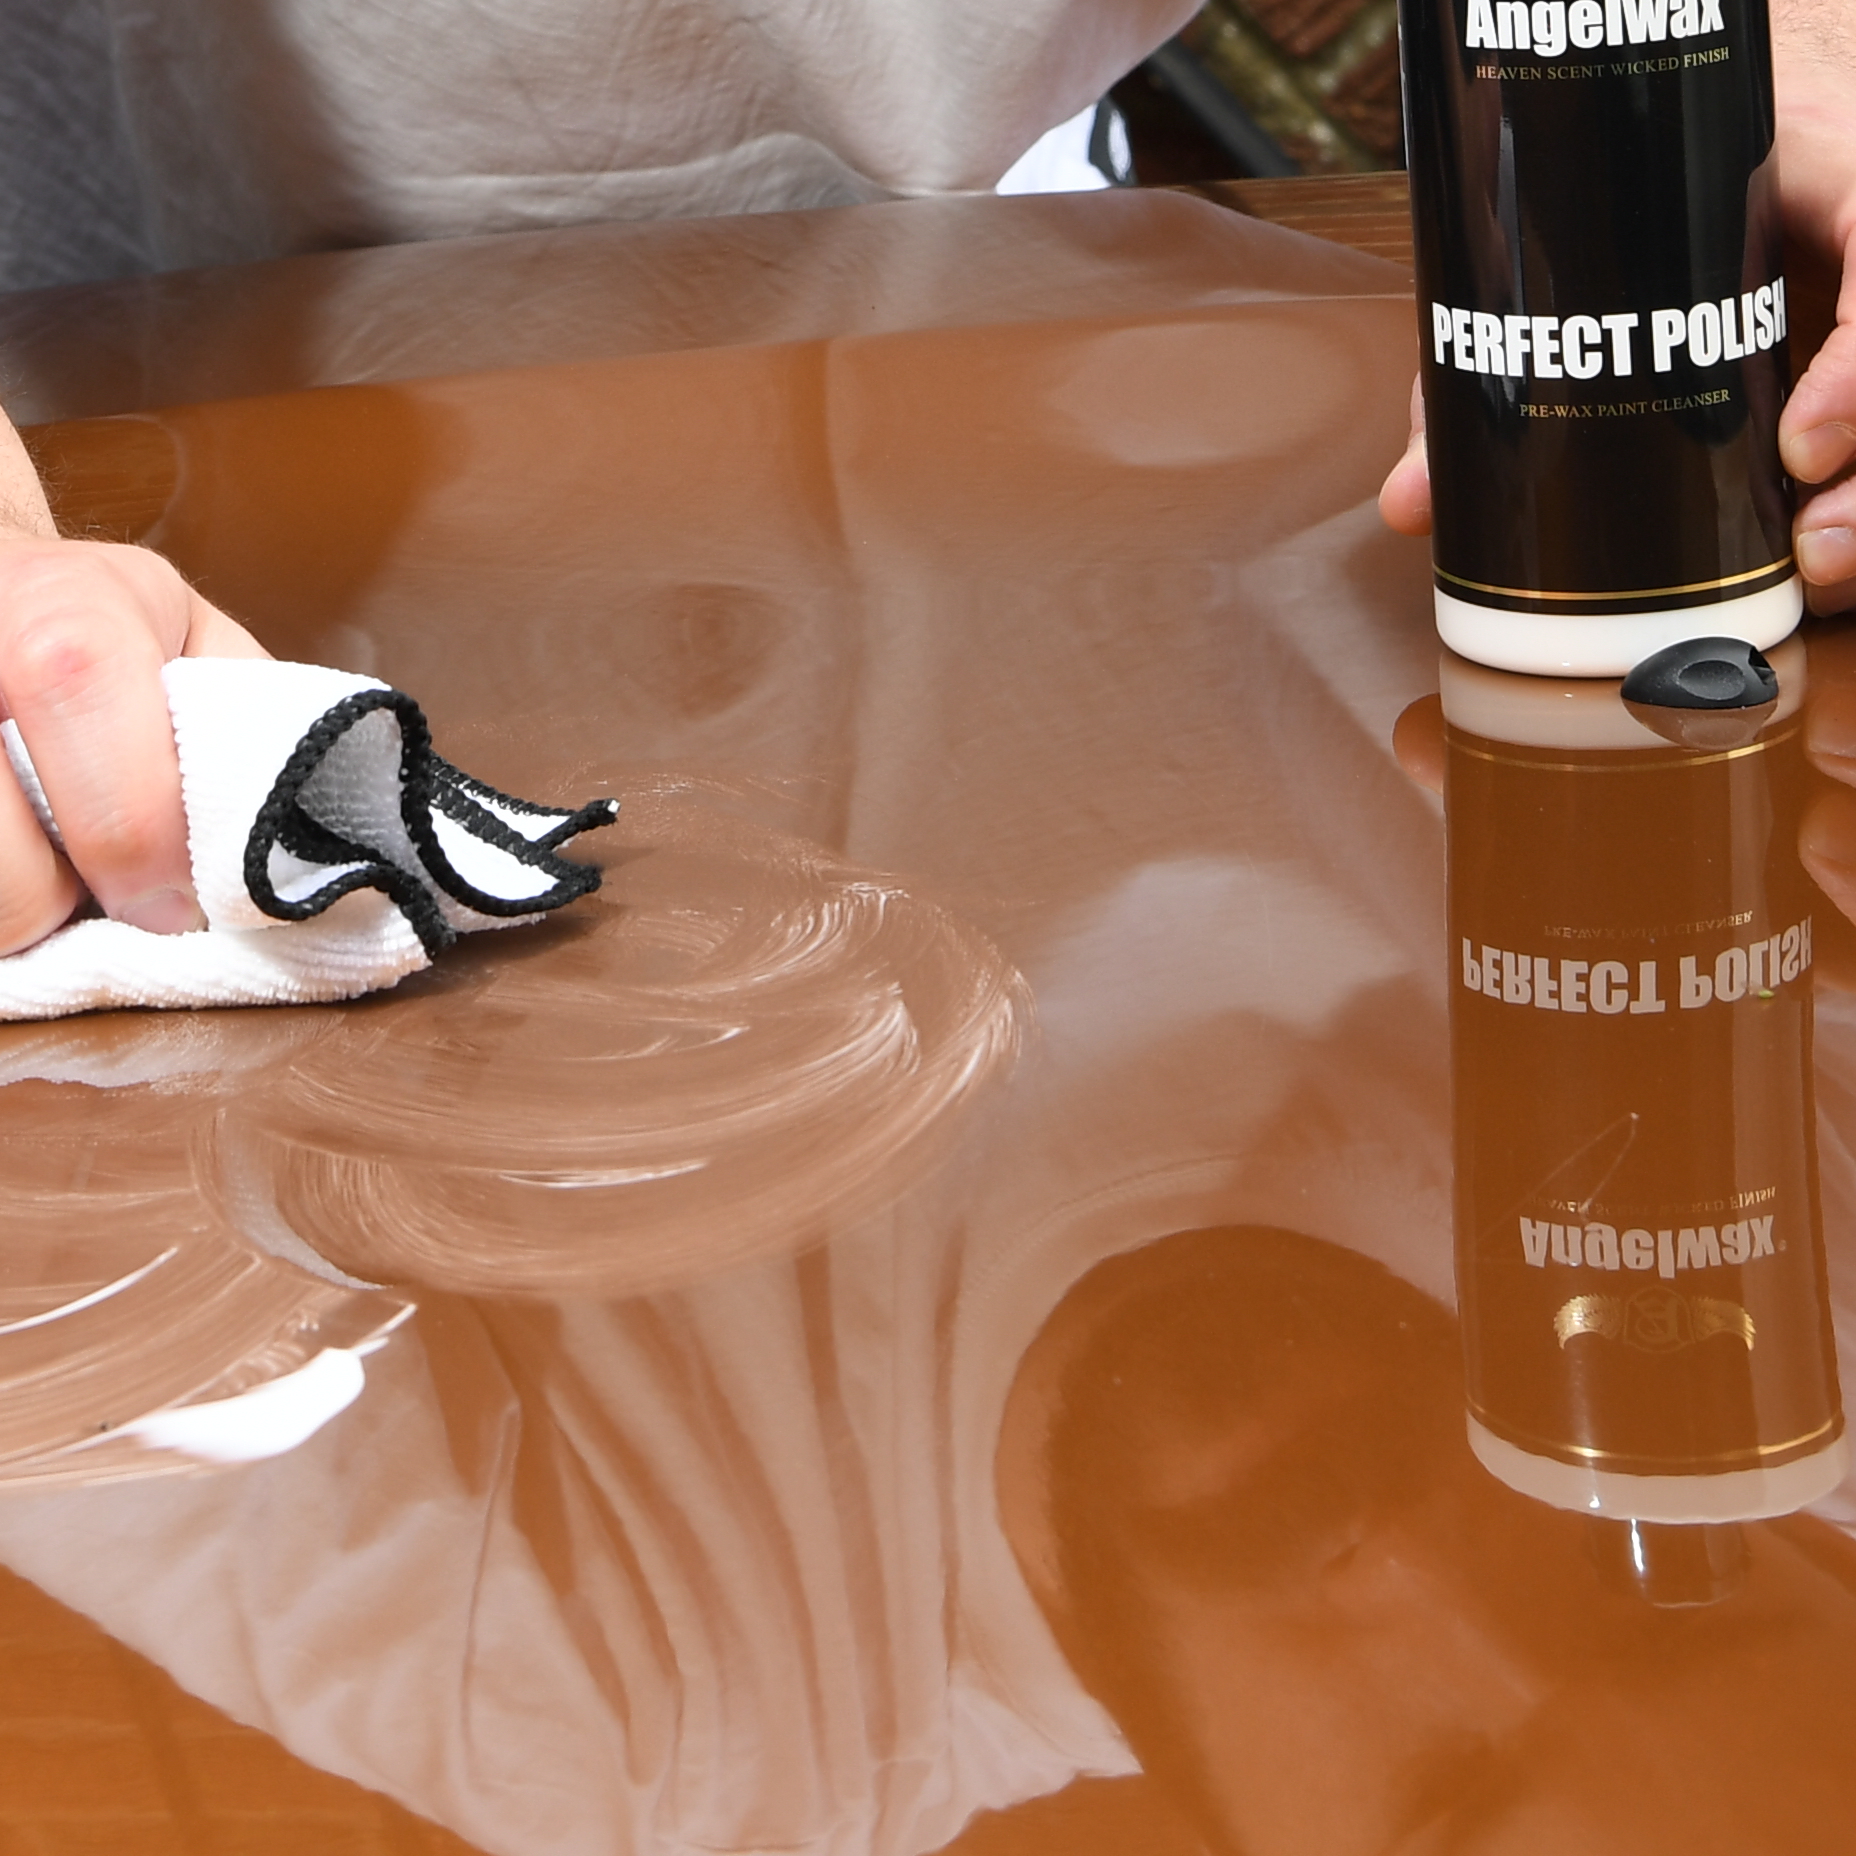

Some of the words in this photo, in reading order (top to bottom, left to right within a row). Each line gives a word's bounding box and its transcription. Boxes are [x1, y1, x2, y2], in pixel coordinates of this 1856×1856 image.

[1476, 65, 1542, 80] HEAVEN
[1547, 65, 1605, 80] SCENT
[1610, 56, 1679, 76] WICKED
[1683, 46, 1730, 68] FINISH
[1432, 301, 1639, 380] PERFECT
[1651, 275, 1787, 373] POLISH
[1519, 403, 1593, 418] PRE-WAX
[1598, 401, 1648, 417] PAINT
[1652, 389, 1731, 413] CLEANSER
